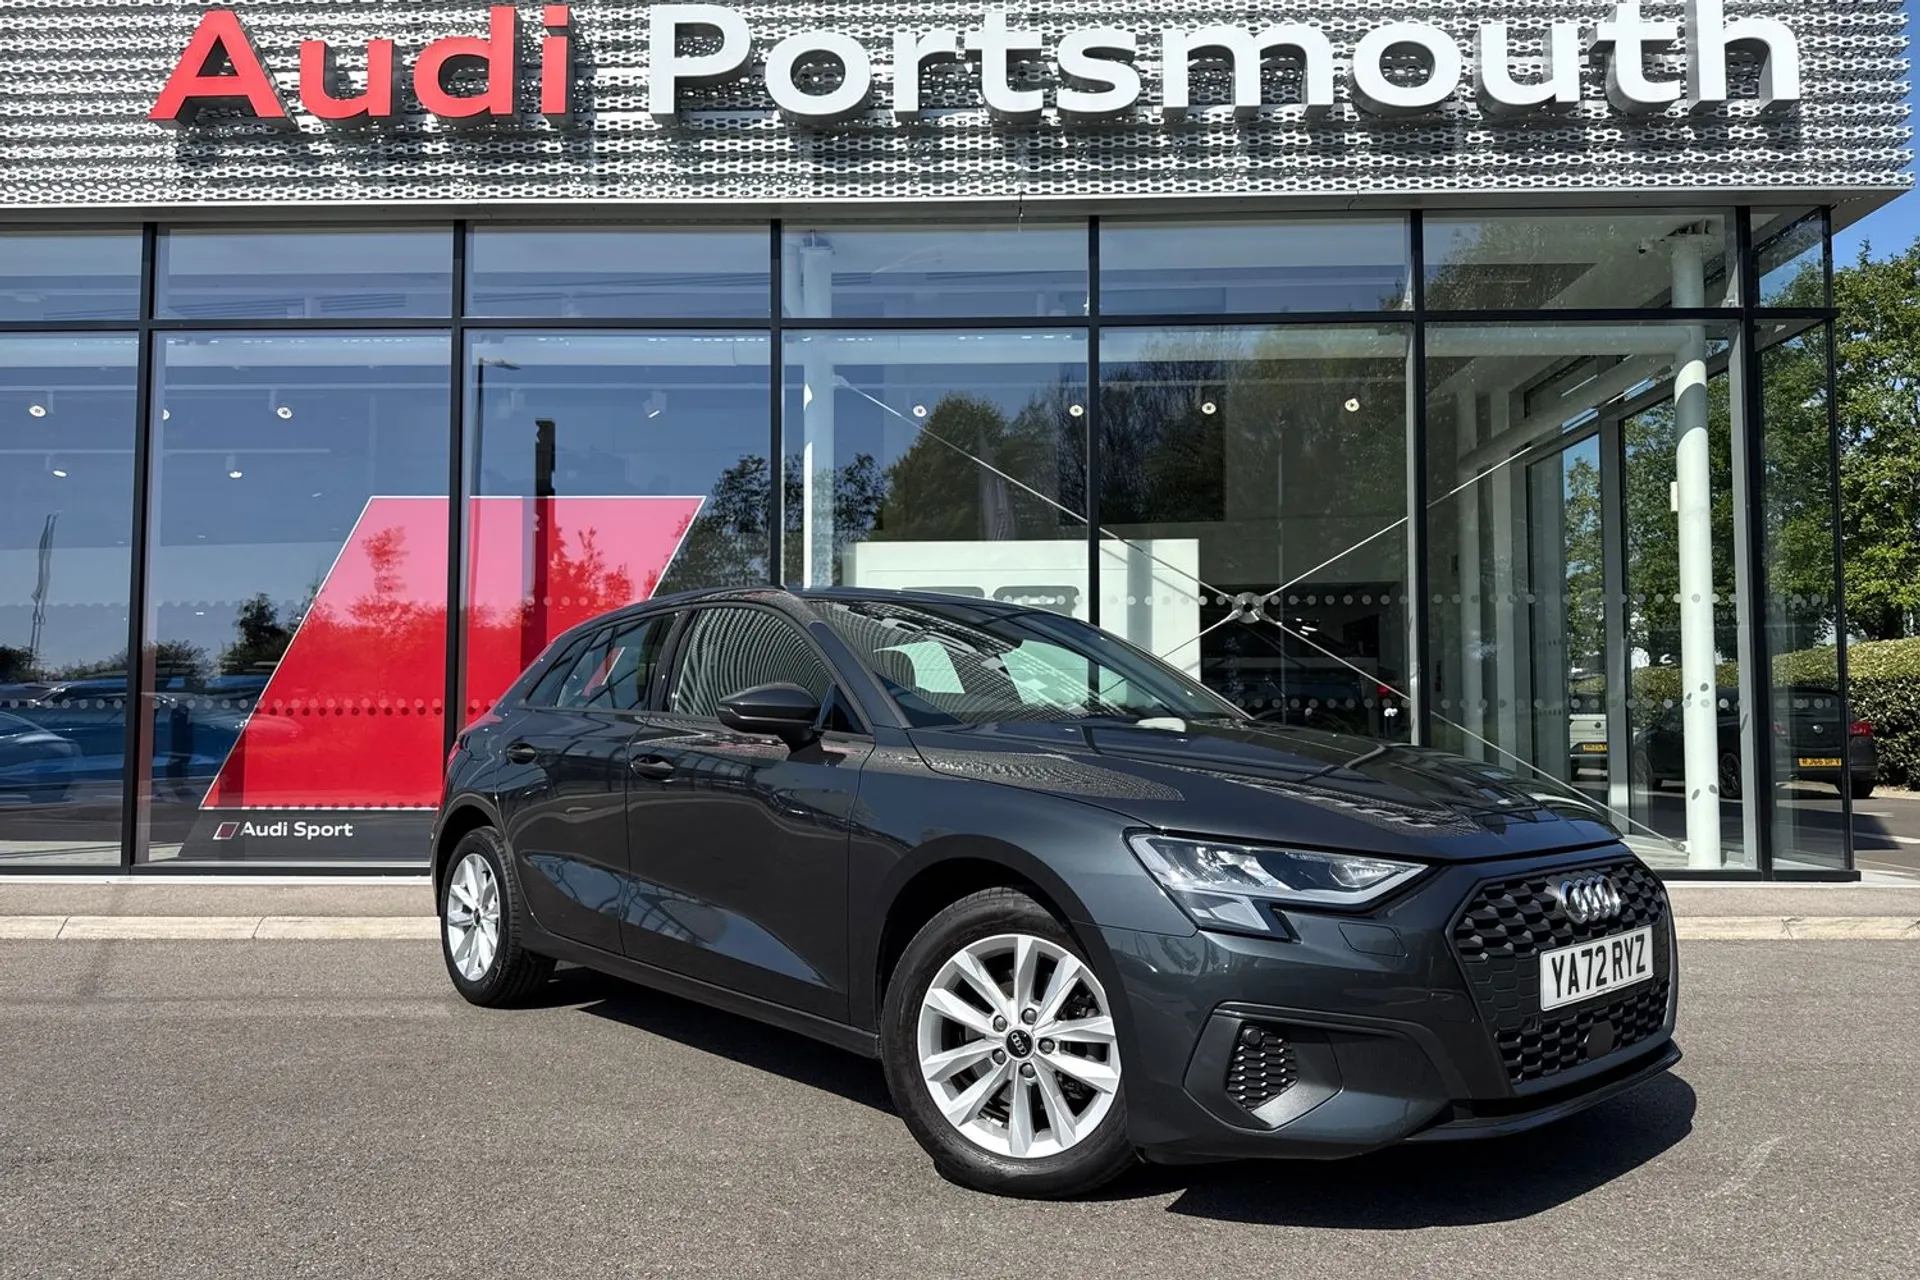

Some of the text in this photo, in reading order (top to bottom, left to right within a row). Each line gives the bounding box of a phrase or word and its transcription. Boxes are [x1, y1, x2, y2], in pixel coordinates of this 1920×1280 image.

[150, 0, 1802, 120] Audi Portsmouth
[240, 821, 354, 840] Audi Sport
[1552, 934, 1646, 998] YA72 RYZ
